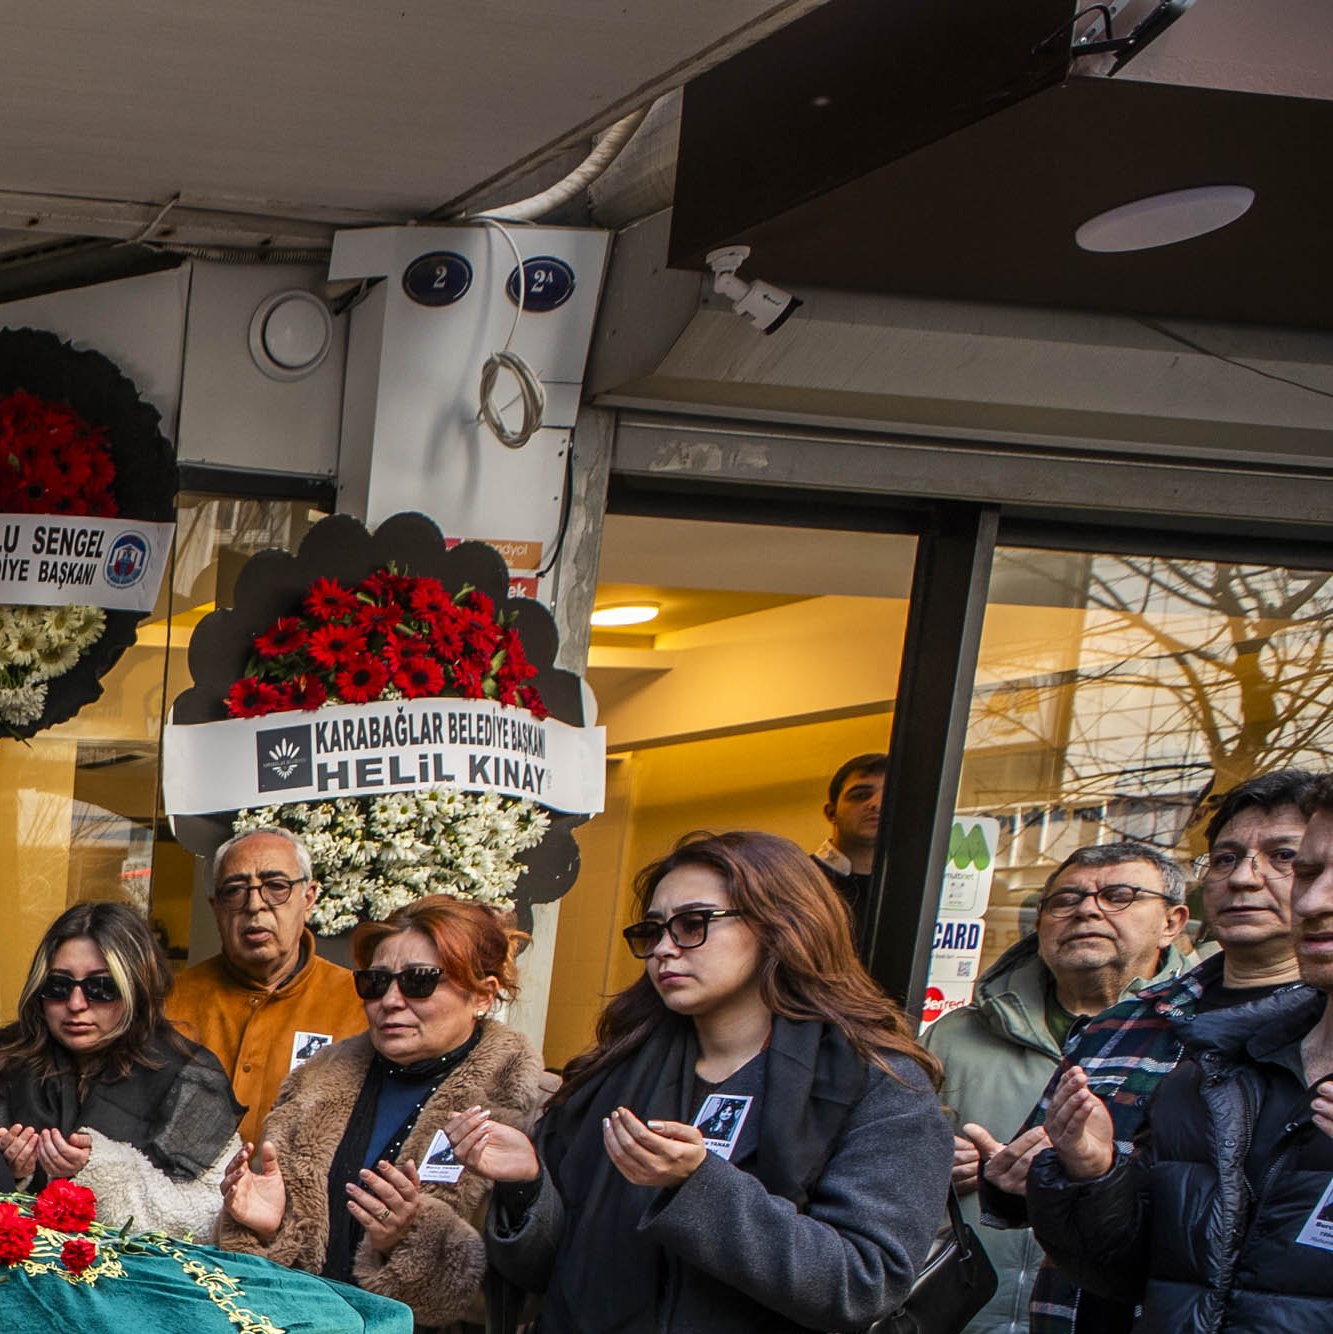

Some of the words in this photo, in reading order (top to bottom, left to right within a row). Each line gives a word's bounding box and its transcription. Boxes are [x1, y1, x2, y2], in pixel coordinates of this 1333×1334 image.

[433, 265, 448, 289] 2
[33, 525, 105, 559] SENGEL
[38, 561, 97, 590] BAŞKANI
[315, 706, 444, 754] KARABAĞLAR
[448, 707, 508, 749] BELEDİYE
[511, 719, 546, 762] BAŞKANI
[469, 754, 545, 795] KINAY
